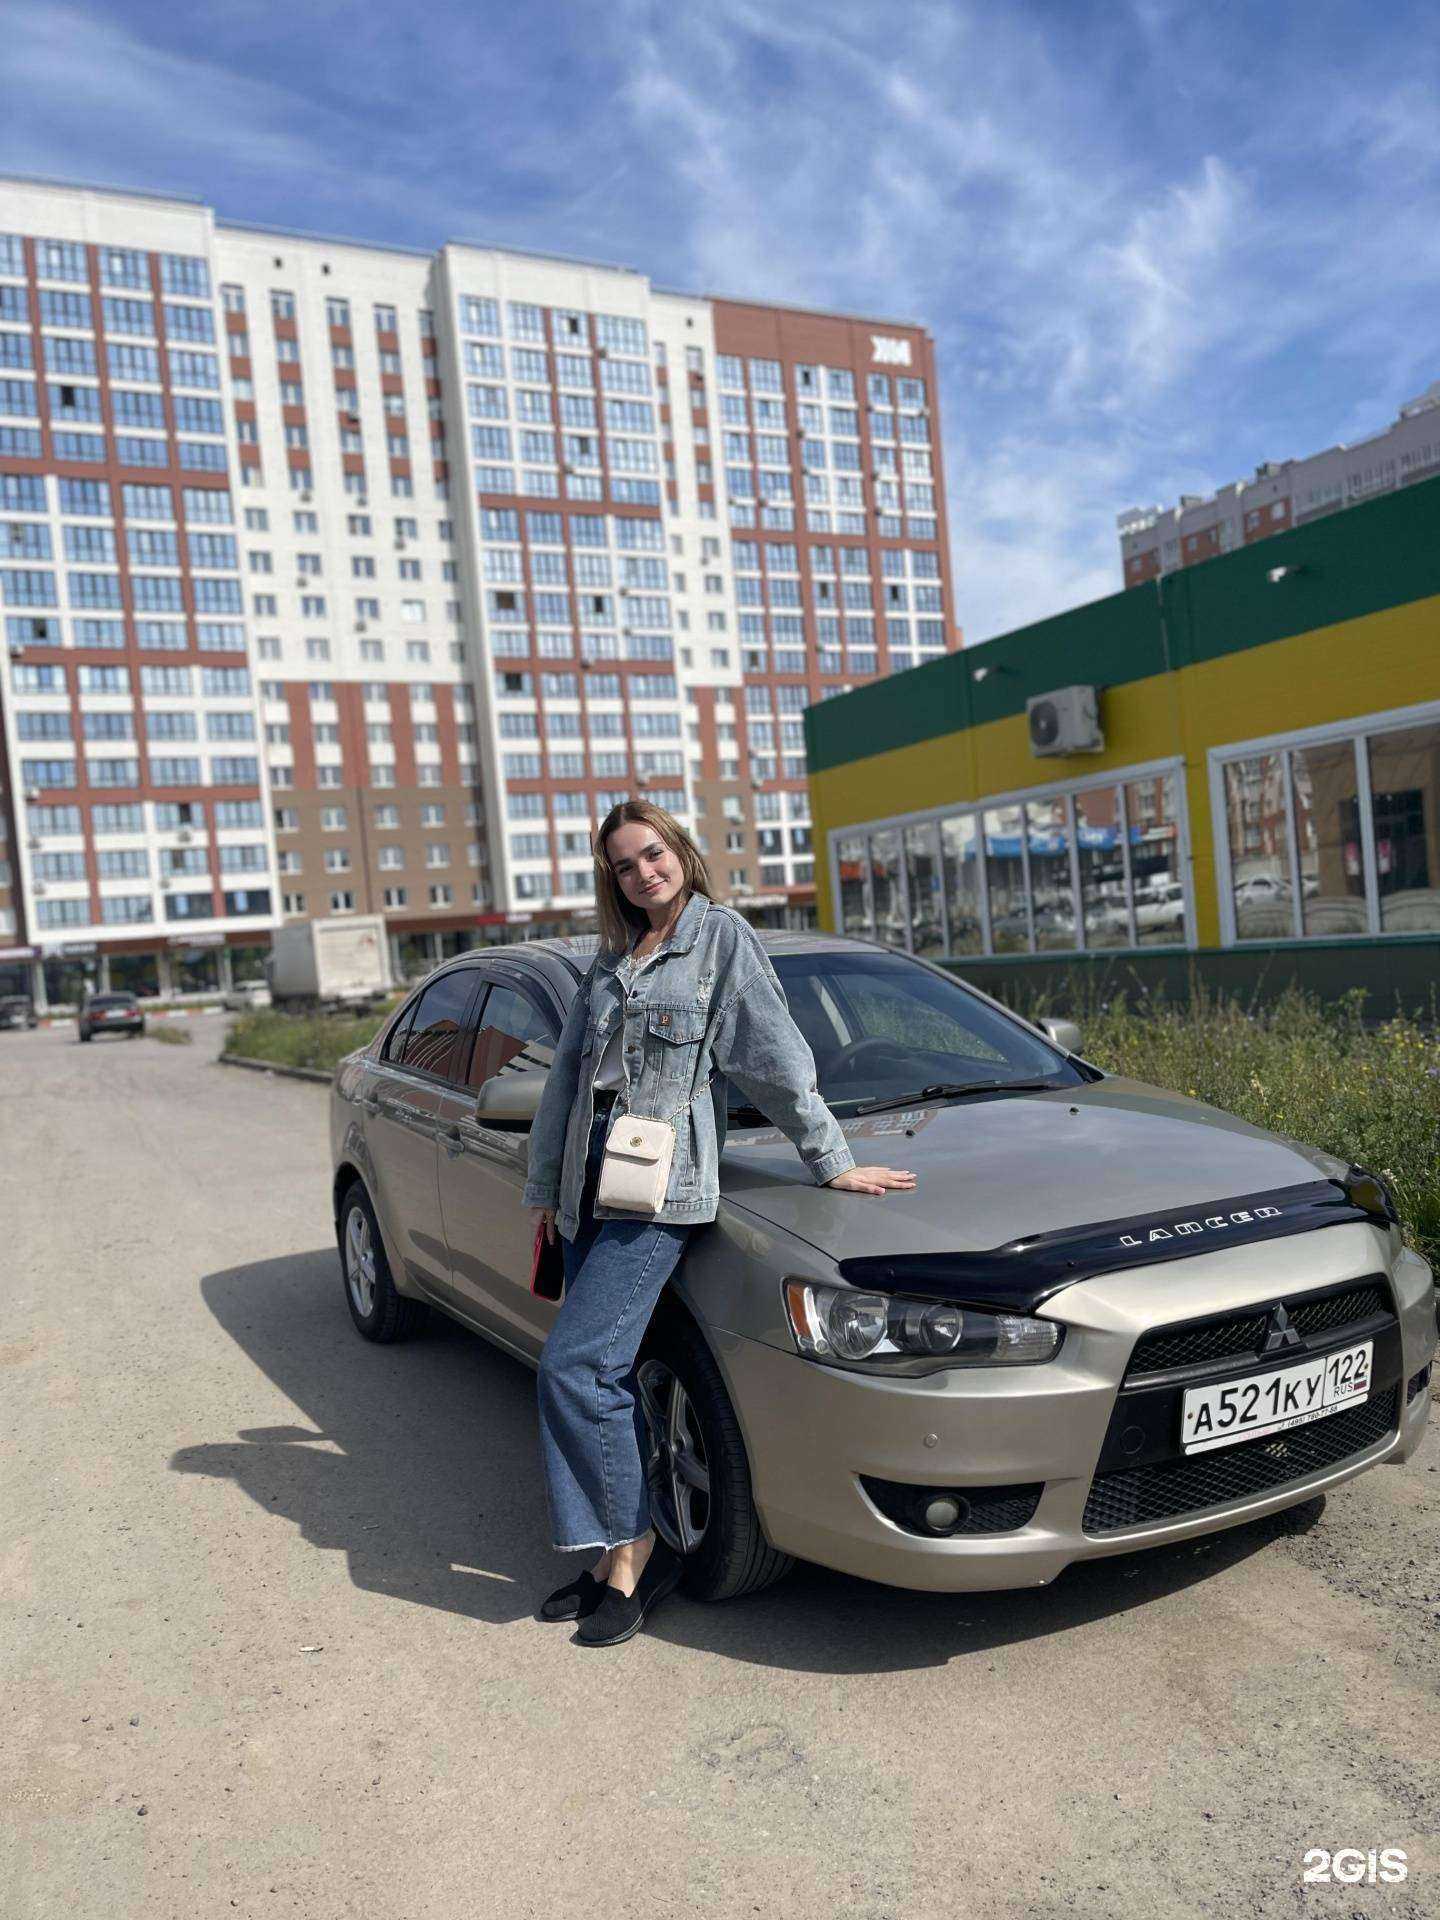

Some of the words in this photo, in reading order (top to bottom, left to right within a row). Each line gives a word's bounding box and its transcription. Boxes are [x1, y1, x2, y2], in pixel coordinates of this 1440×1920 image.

[1120, 1207, 1282, 1246] LANCER
[1193, 1374, 1321, 1436] А521КУ
[1328, 1349, 1366, 1386] 122
[1333, 1382, 1354, 1397] RUS
